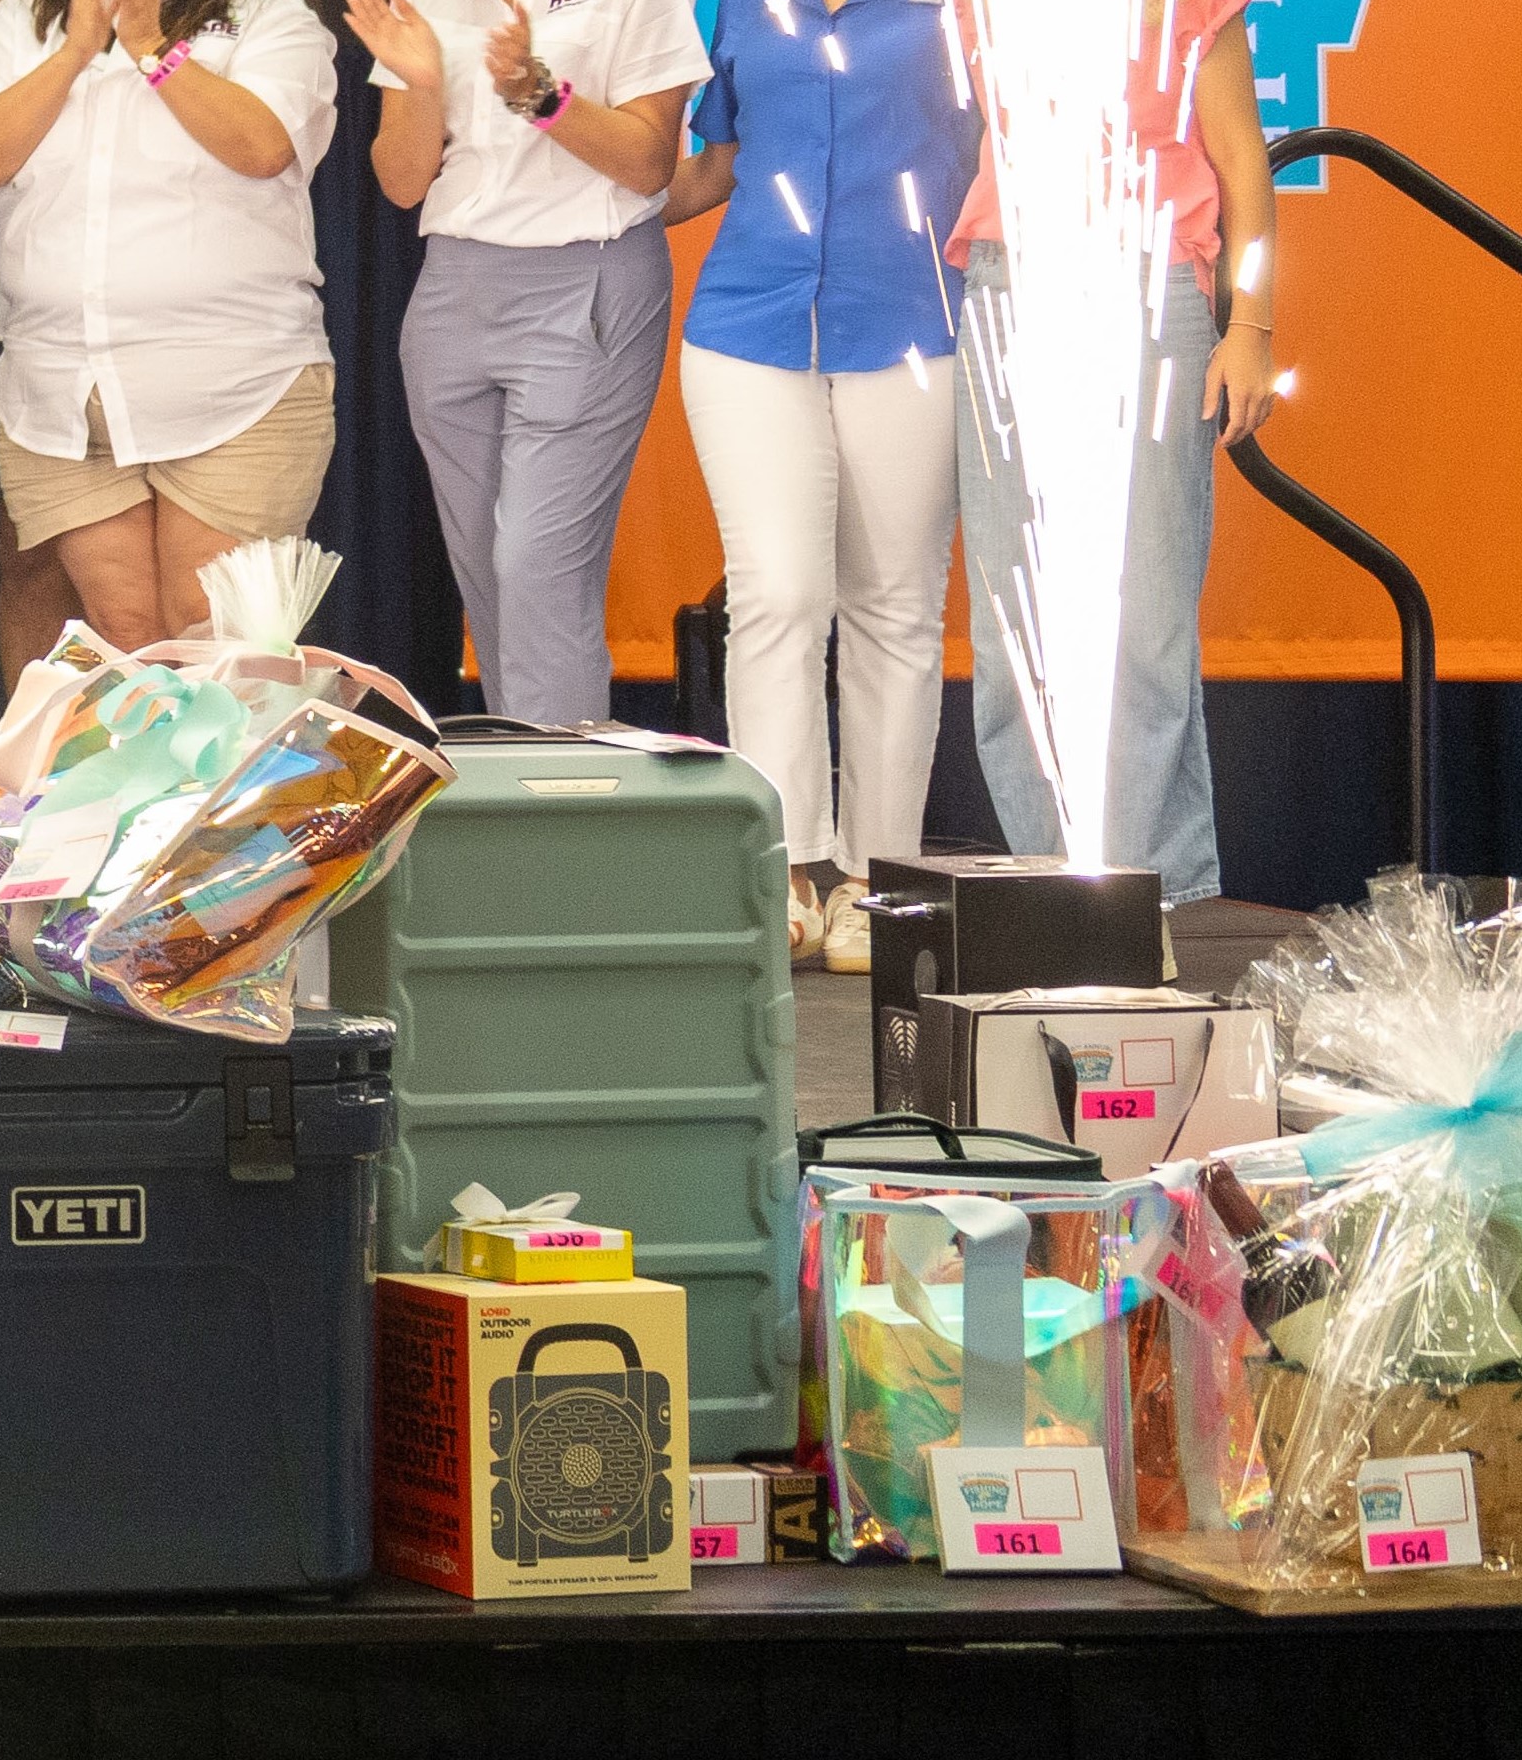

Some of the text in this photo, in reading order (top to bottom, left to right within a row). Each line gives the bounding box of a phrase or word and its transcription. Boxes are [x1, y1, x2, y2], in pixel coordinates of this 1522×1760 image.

[1096, 1099, 1138, 1119] 162
[20, 1198, 133, 1234] YETI
[480, 1318, 531, 1329] OUTDOOR
[481, 1329, 514, 1340] AUDIO
[693, 1536, 722, 1558] 57
[993, 1533, 1043, 1555] 161
[1386, 1540, 1431, 1565] 164
